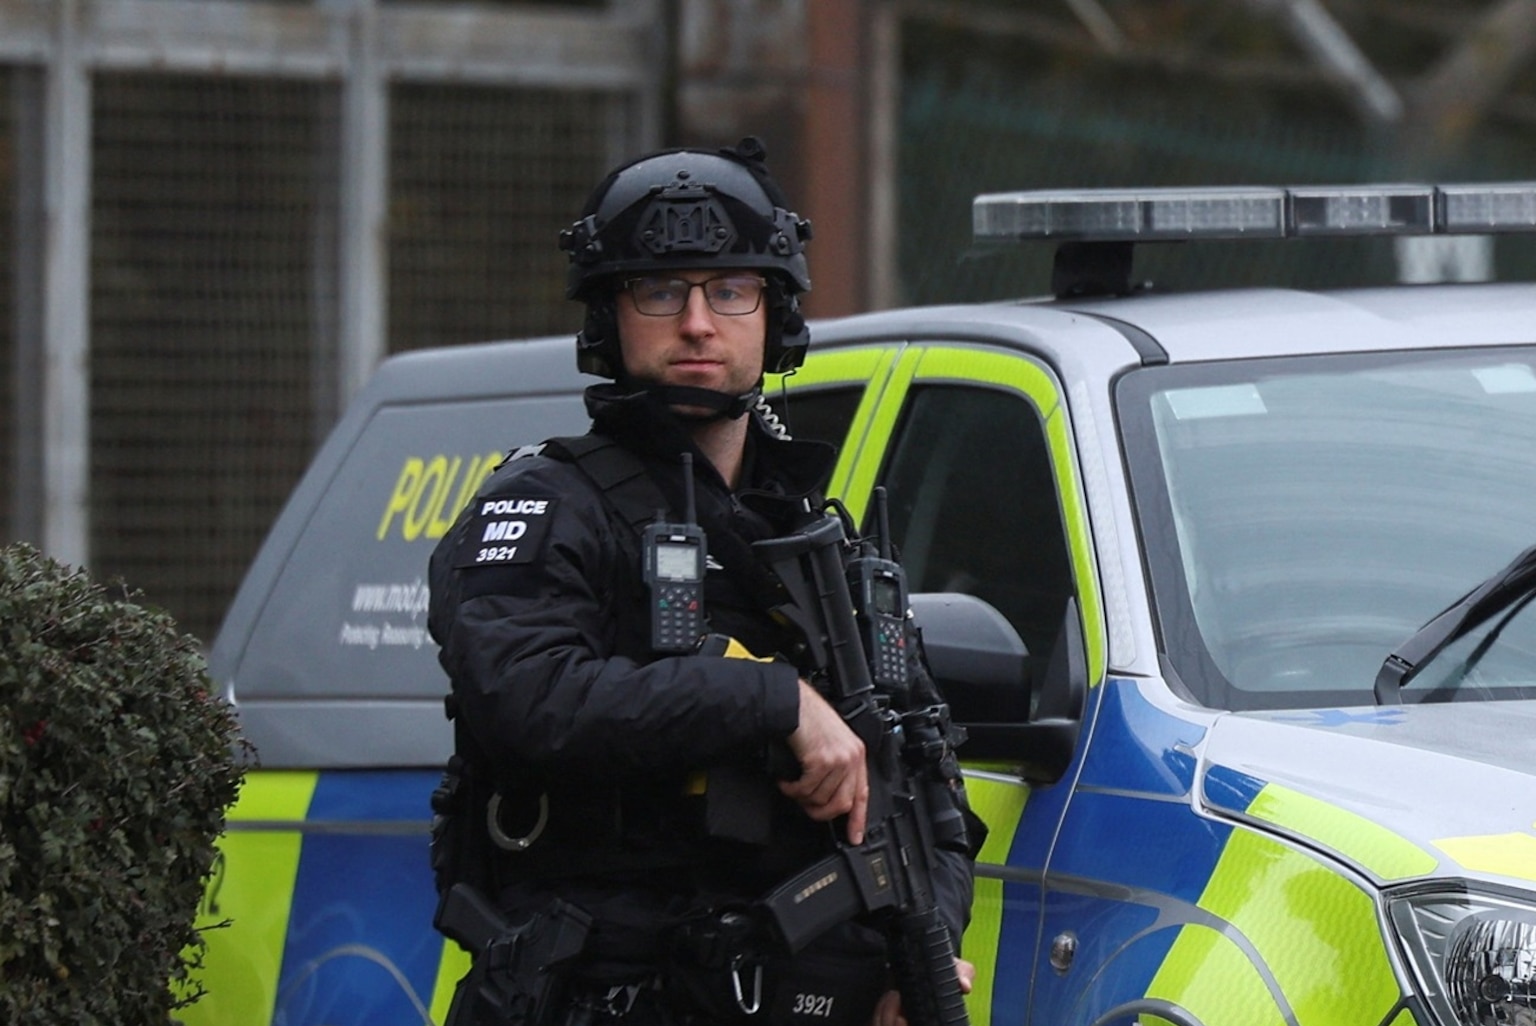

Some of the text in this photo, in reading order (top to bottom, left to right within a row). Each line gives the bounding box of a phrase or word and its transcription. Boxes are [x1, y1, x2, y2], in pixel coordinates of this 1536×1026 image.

[481, 499, 548, 516] POLICE
[482, 520, 527, 543] MD
[475, 546, 517, 563] 3921
[793, 993, 835, 1018] 3921
